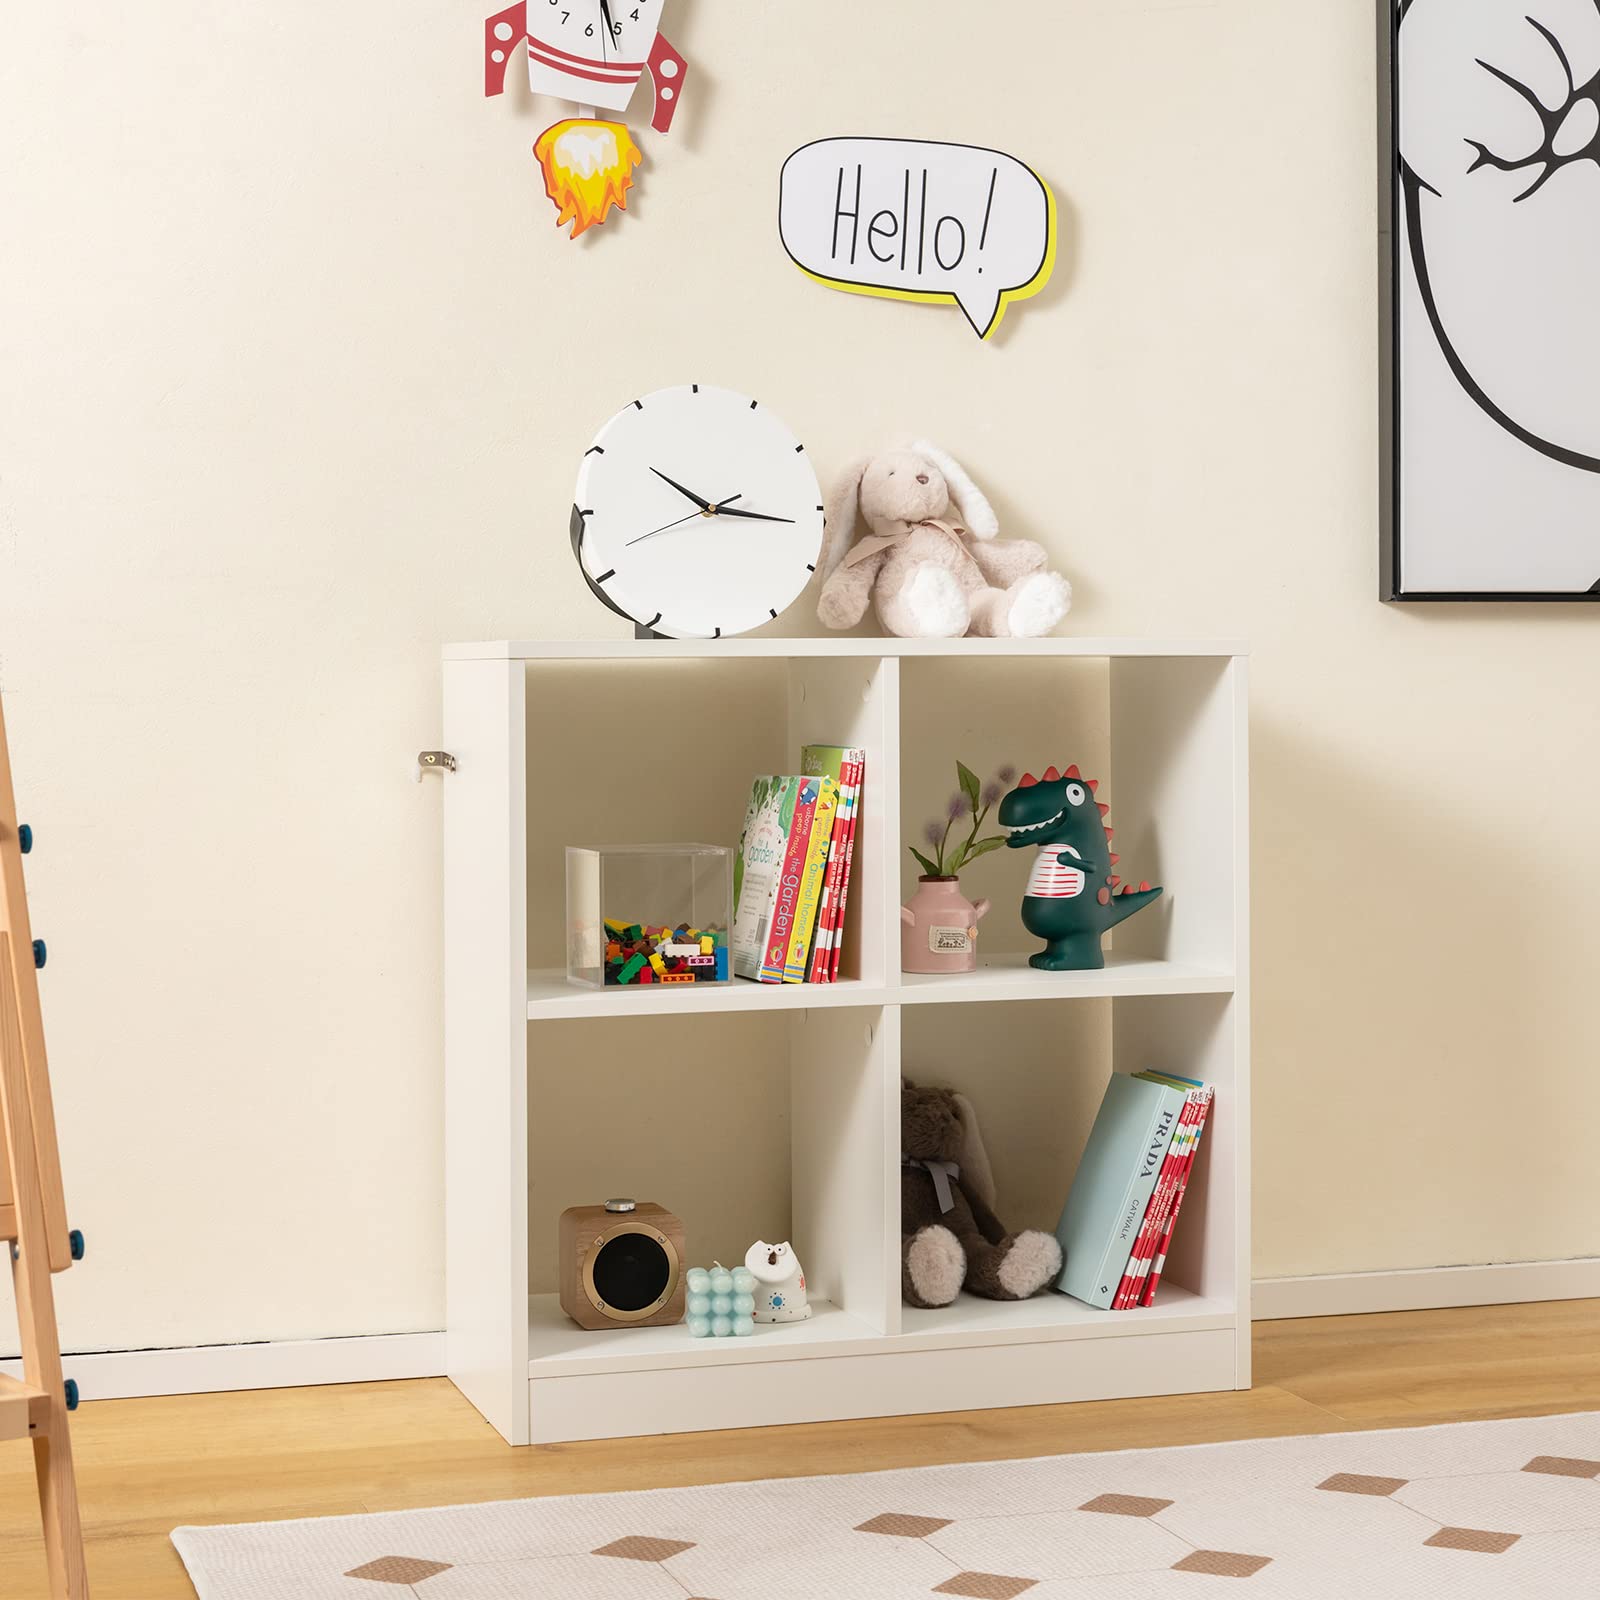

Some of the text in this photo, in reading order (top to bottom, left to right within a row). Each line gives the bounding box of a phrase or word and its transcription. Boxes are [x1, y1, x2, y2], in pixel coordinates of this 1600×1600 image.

[561, 11, 570, 24] 7
[584, 23, 594, 37] 6
[612, 22, 623, 35] 5
[630, 8, 640, 21] 4
[832, 164, 997, 275] Hello!
[802, 807, 812, 836] usborne
[775, 813, 803, 937] peep inside the garden
[804, 863, 819, 901] animal
[798, 903, 813, 937] homes
[1139, 1111, 1174, 1178] PRADA
[1120, 1199, 1140, 1241] CATWALK
